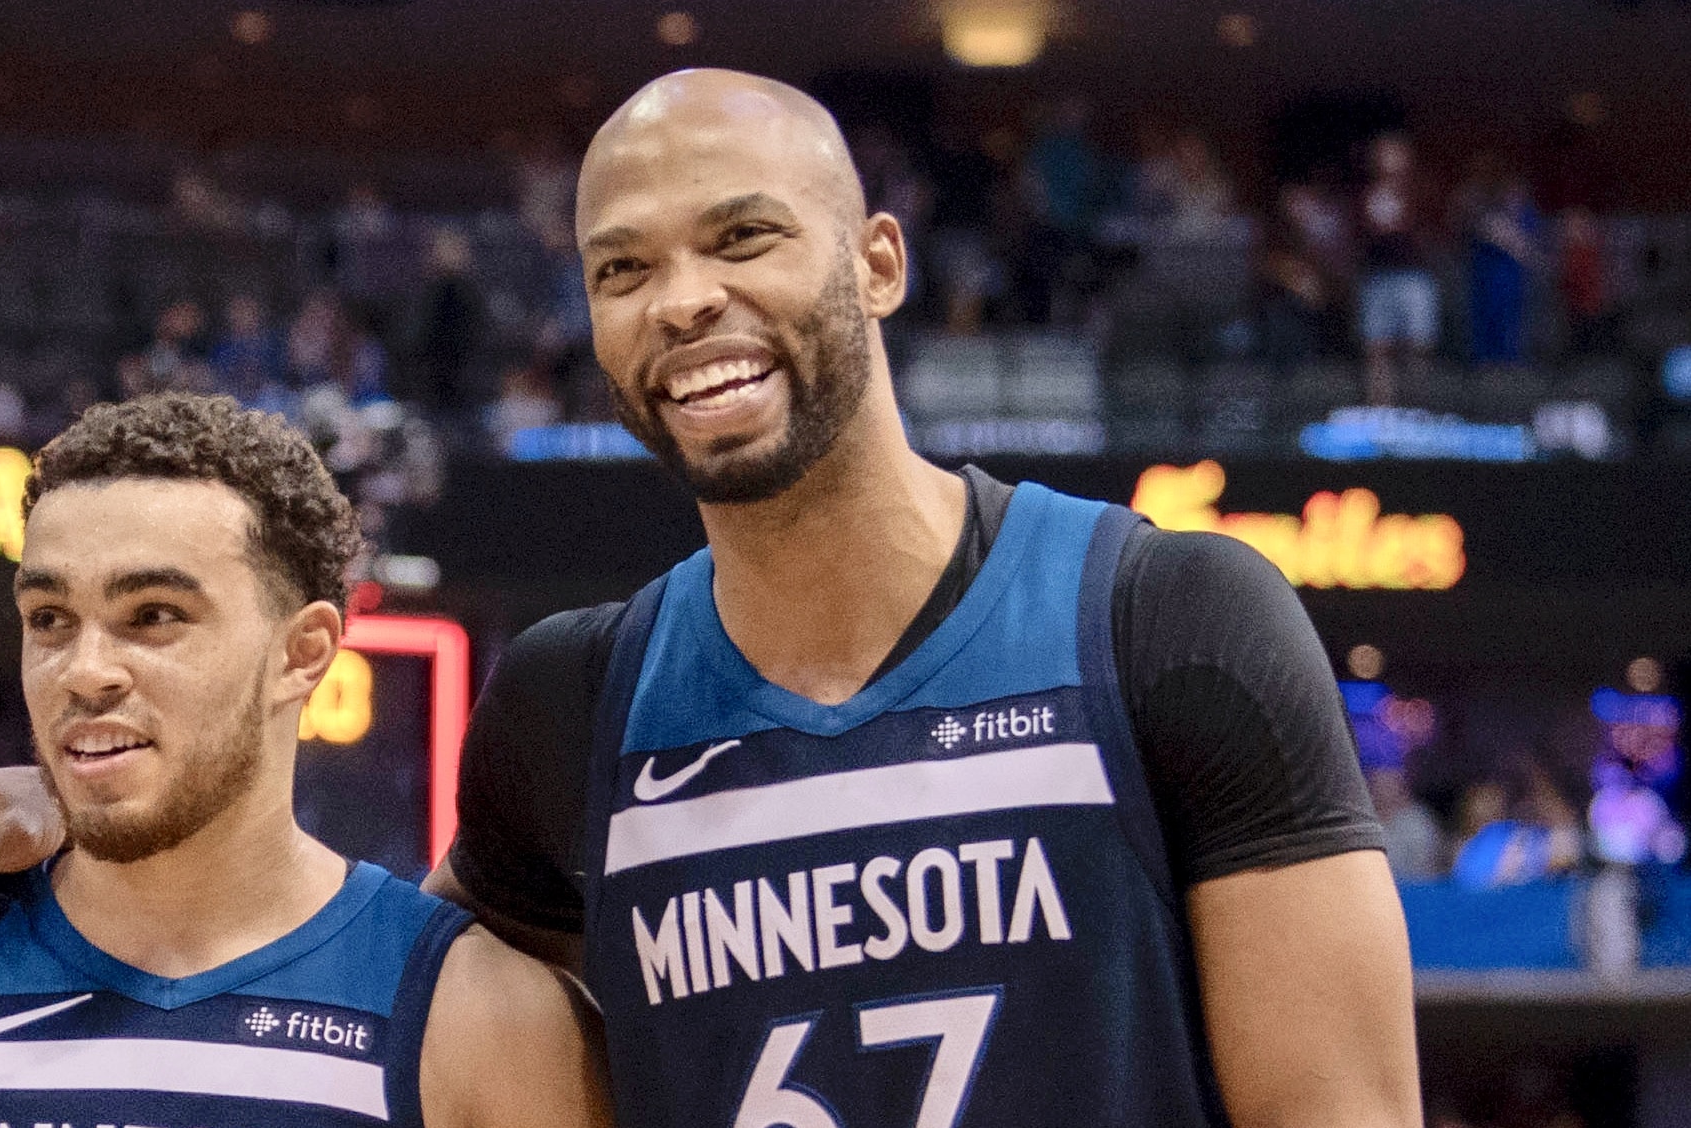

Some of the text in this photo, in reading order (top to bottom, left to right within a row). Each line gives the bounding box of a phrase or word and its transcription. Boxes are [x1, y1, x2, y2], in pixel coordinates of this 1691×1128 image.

[973, 706, 1055, 743] fitbit
[631, 836, 1073, 1006] MINNESOTA
[285, 1010, 369, 1051] fitbit
